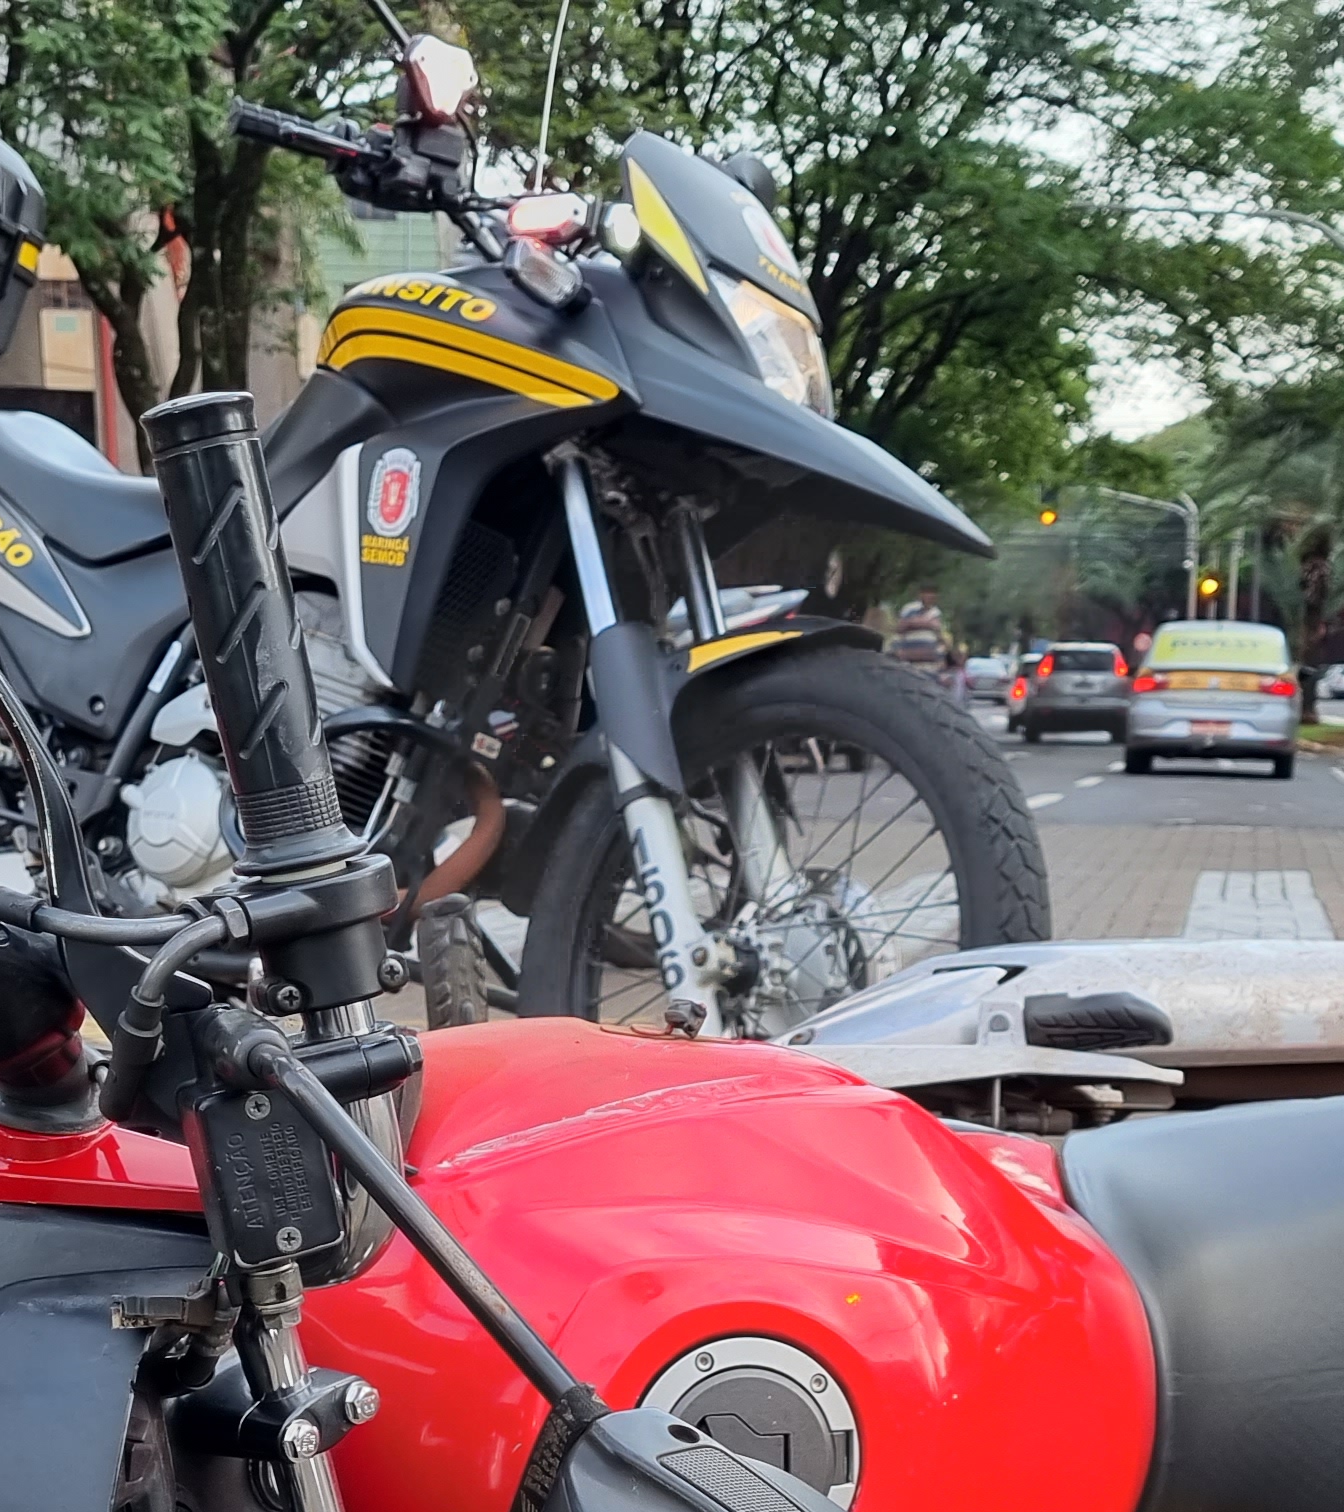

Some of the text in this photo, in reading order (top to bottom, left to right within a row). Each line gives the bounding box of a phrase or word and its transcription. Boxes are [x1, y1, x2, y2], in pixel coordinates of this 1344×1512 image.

[632, 827, 684, 990] 1506
[225, 1132, 265, 1229] ATENÇÃO
[260, 1132, 282, 1189] SOMENTE
[285, 1124, 313, 1212] ESPECIFICADO
